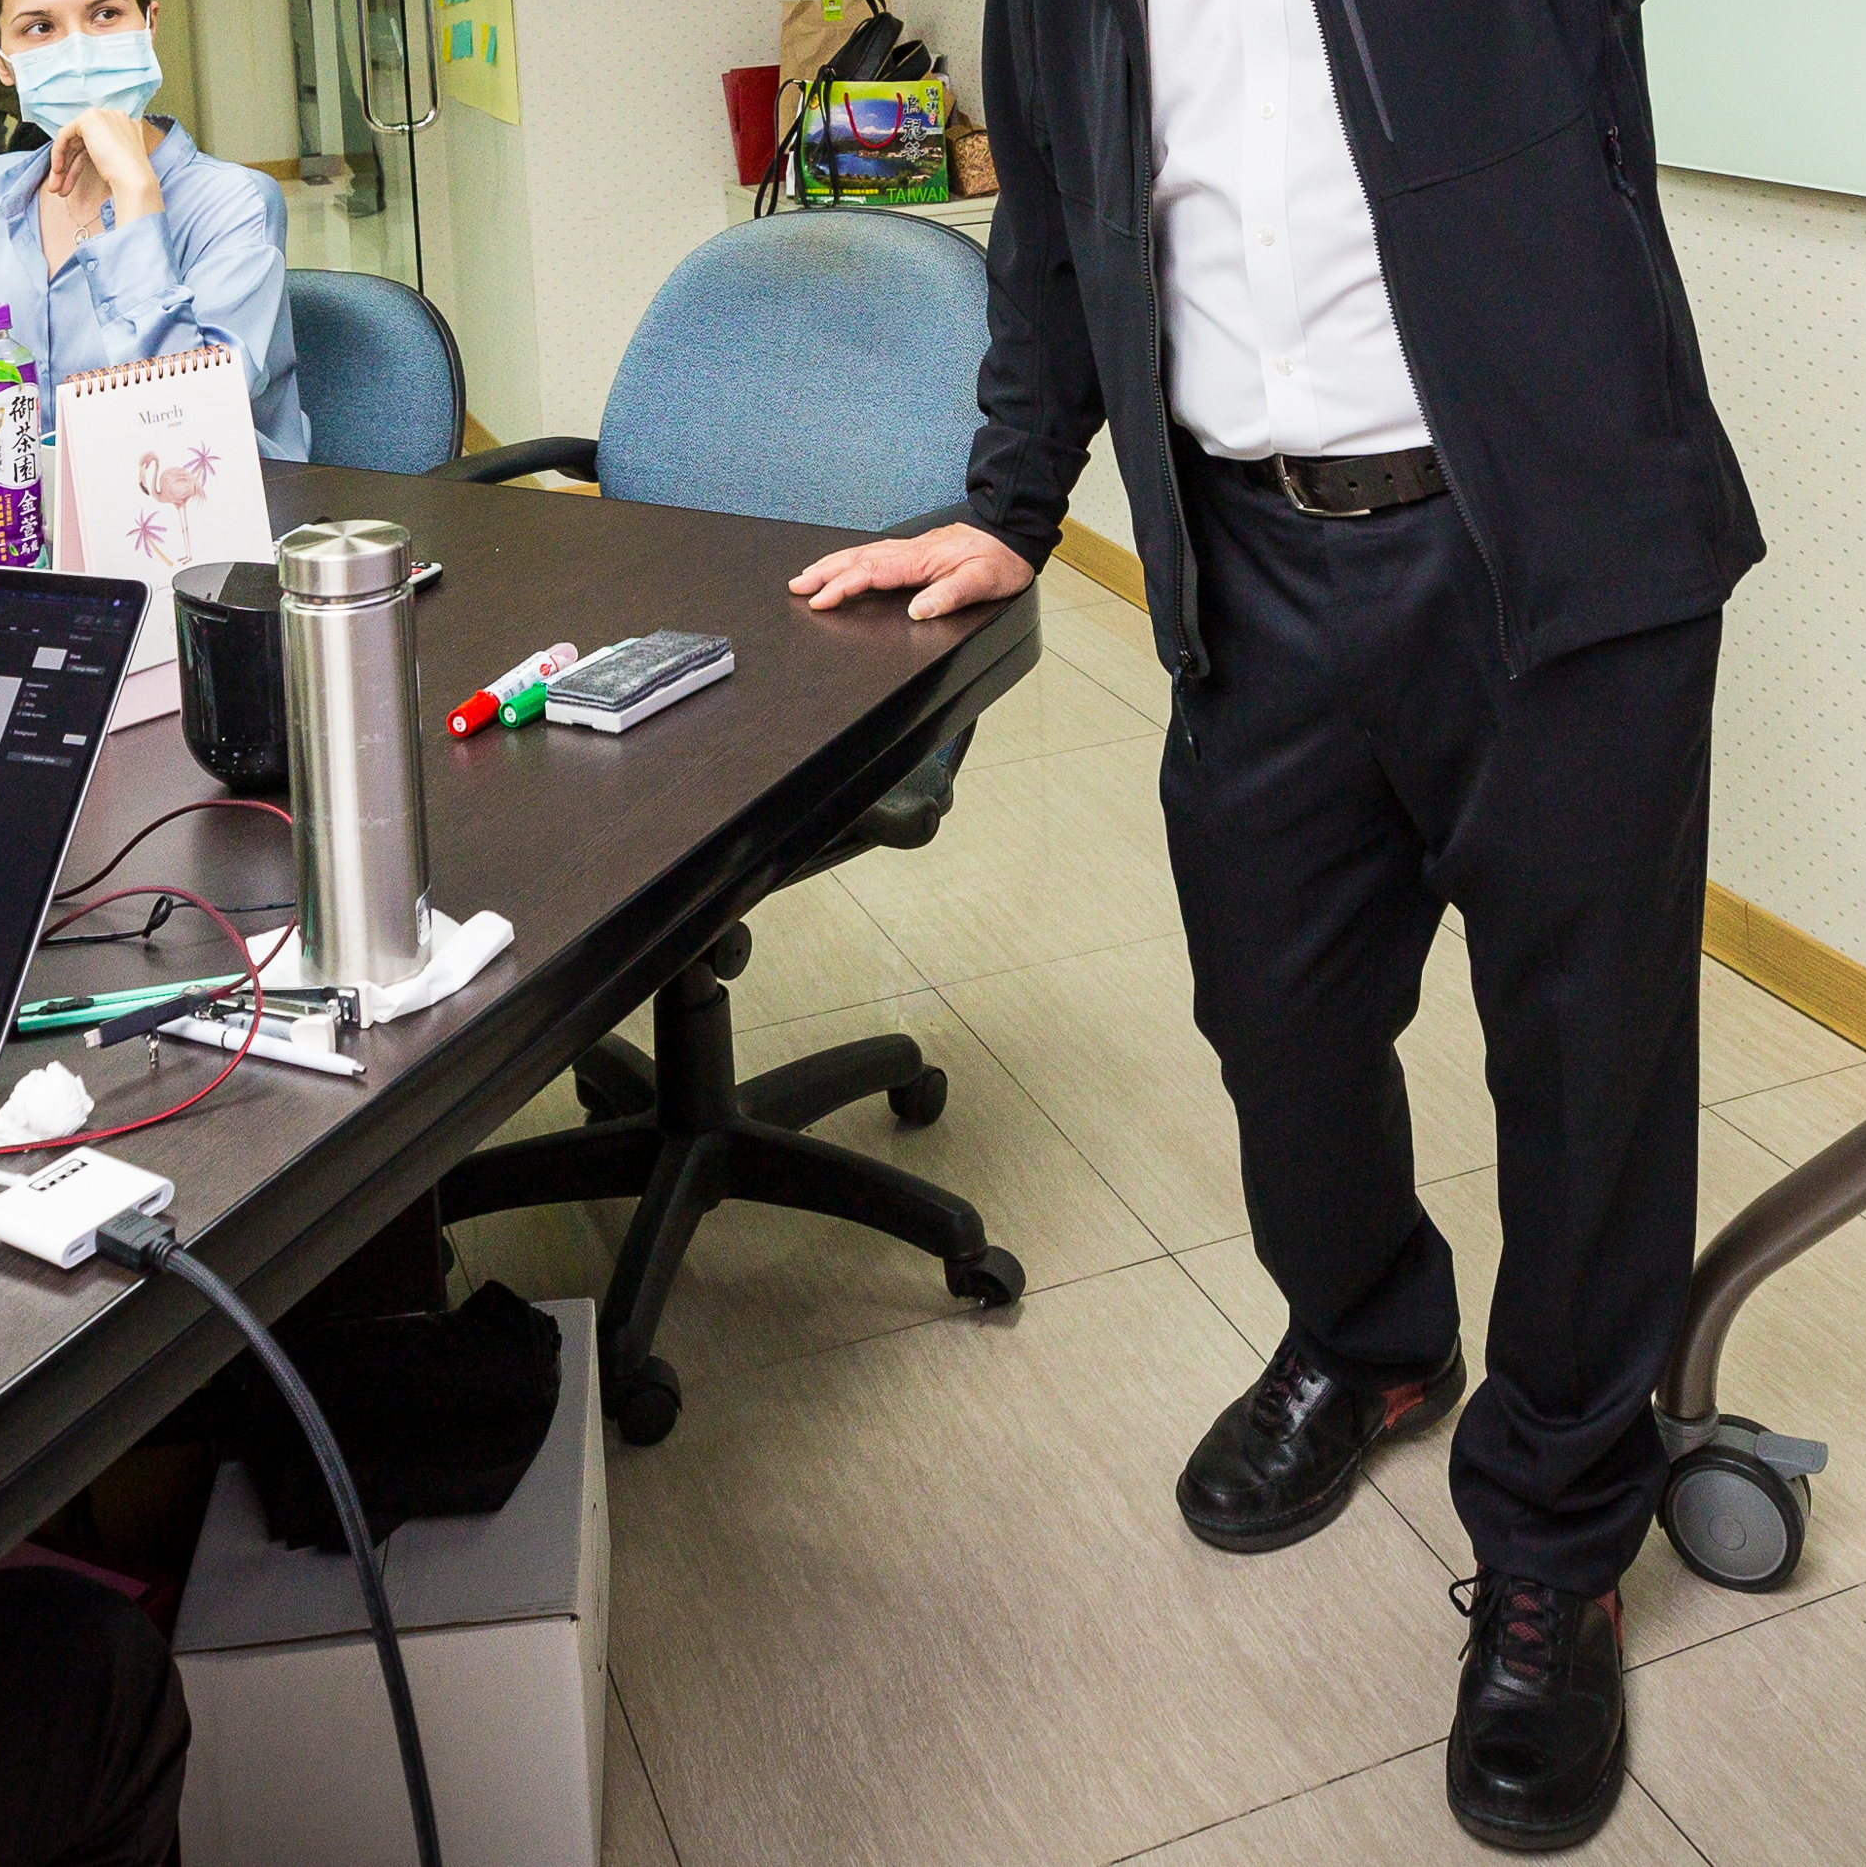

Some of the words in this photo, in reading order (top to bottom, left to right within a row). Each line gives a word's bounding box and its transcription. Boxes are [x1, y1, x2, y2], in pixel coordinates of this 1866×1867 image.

[886, 187, 948, 203] TAIWAN
[139, 404, 183, 427] March
[9, 395, 37, 484] 御茶園
[17, 489, 39, 542] 金萱
